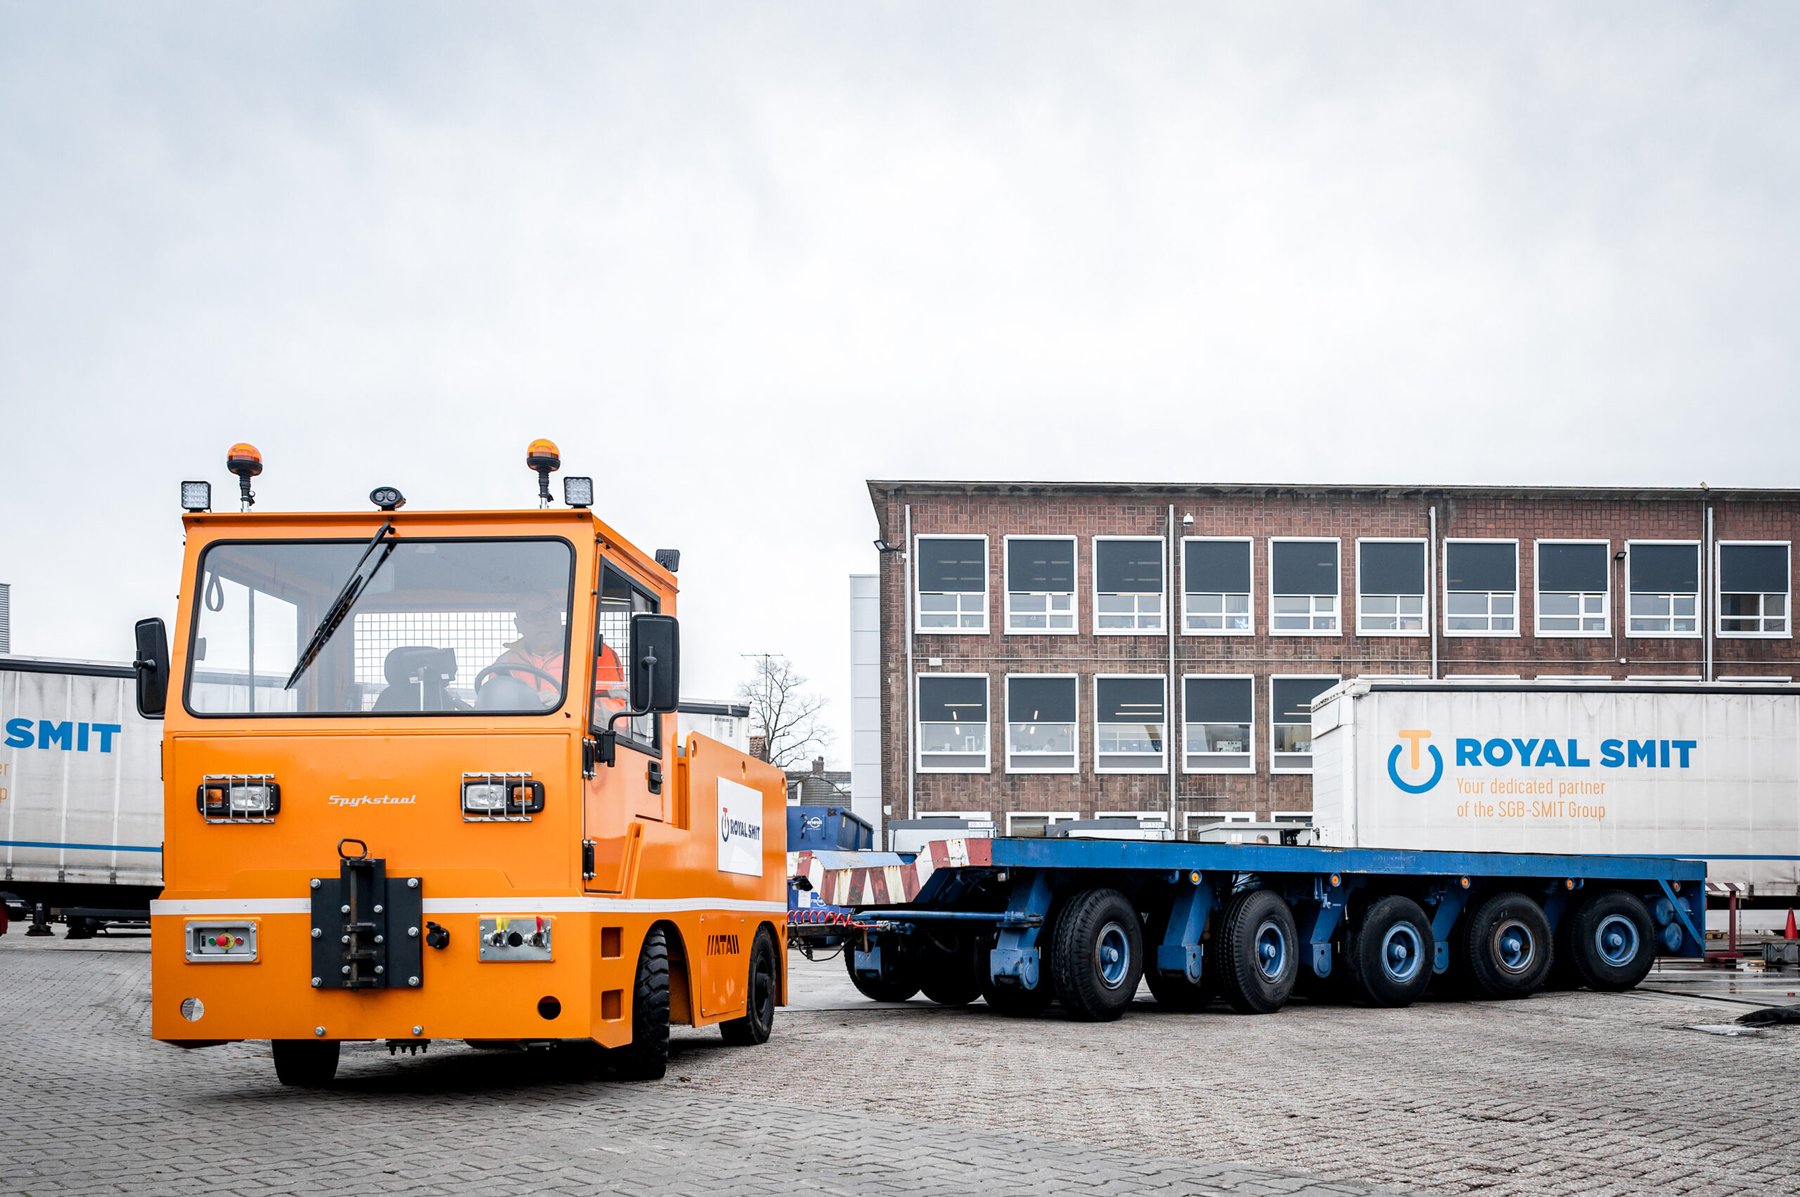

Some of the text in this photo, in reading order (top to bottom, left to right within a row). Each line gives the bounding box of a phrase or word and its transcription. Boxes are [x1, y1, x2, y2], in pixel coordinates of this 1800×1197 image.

[4, 717, 121, 753] SMIT
[1456, 738, 1697, 768] ROYAL SMIT
[1457, 777, 1606, 798] Your dedicated partner
[1457, 800, 1606, 821] of the SGB-SMIT Group
[730, 818, 760, 840] ROYAL SMIT
